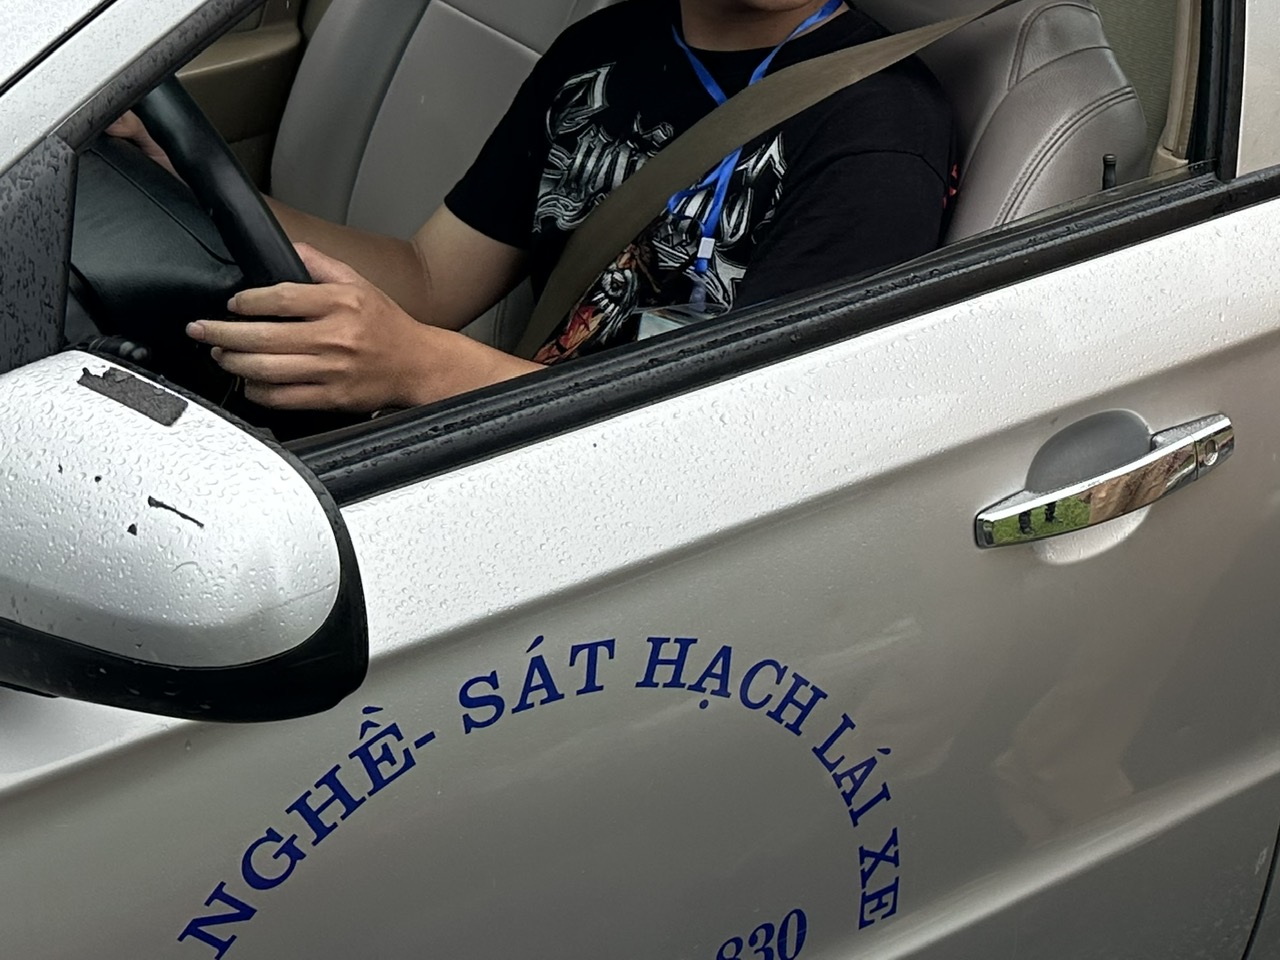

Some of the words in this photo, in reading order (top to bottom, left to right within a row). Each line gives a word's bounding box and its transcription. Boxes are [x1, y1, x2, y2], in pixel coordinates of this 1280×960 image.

[458, 636, 616, 733] SÁT
[636, 636, 828, 736] HẠCH
[811, 714, 892, 827] LÁI
[858, 828, 900, 928] XE
